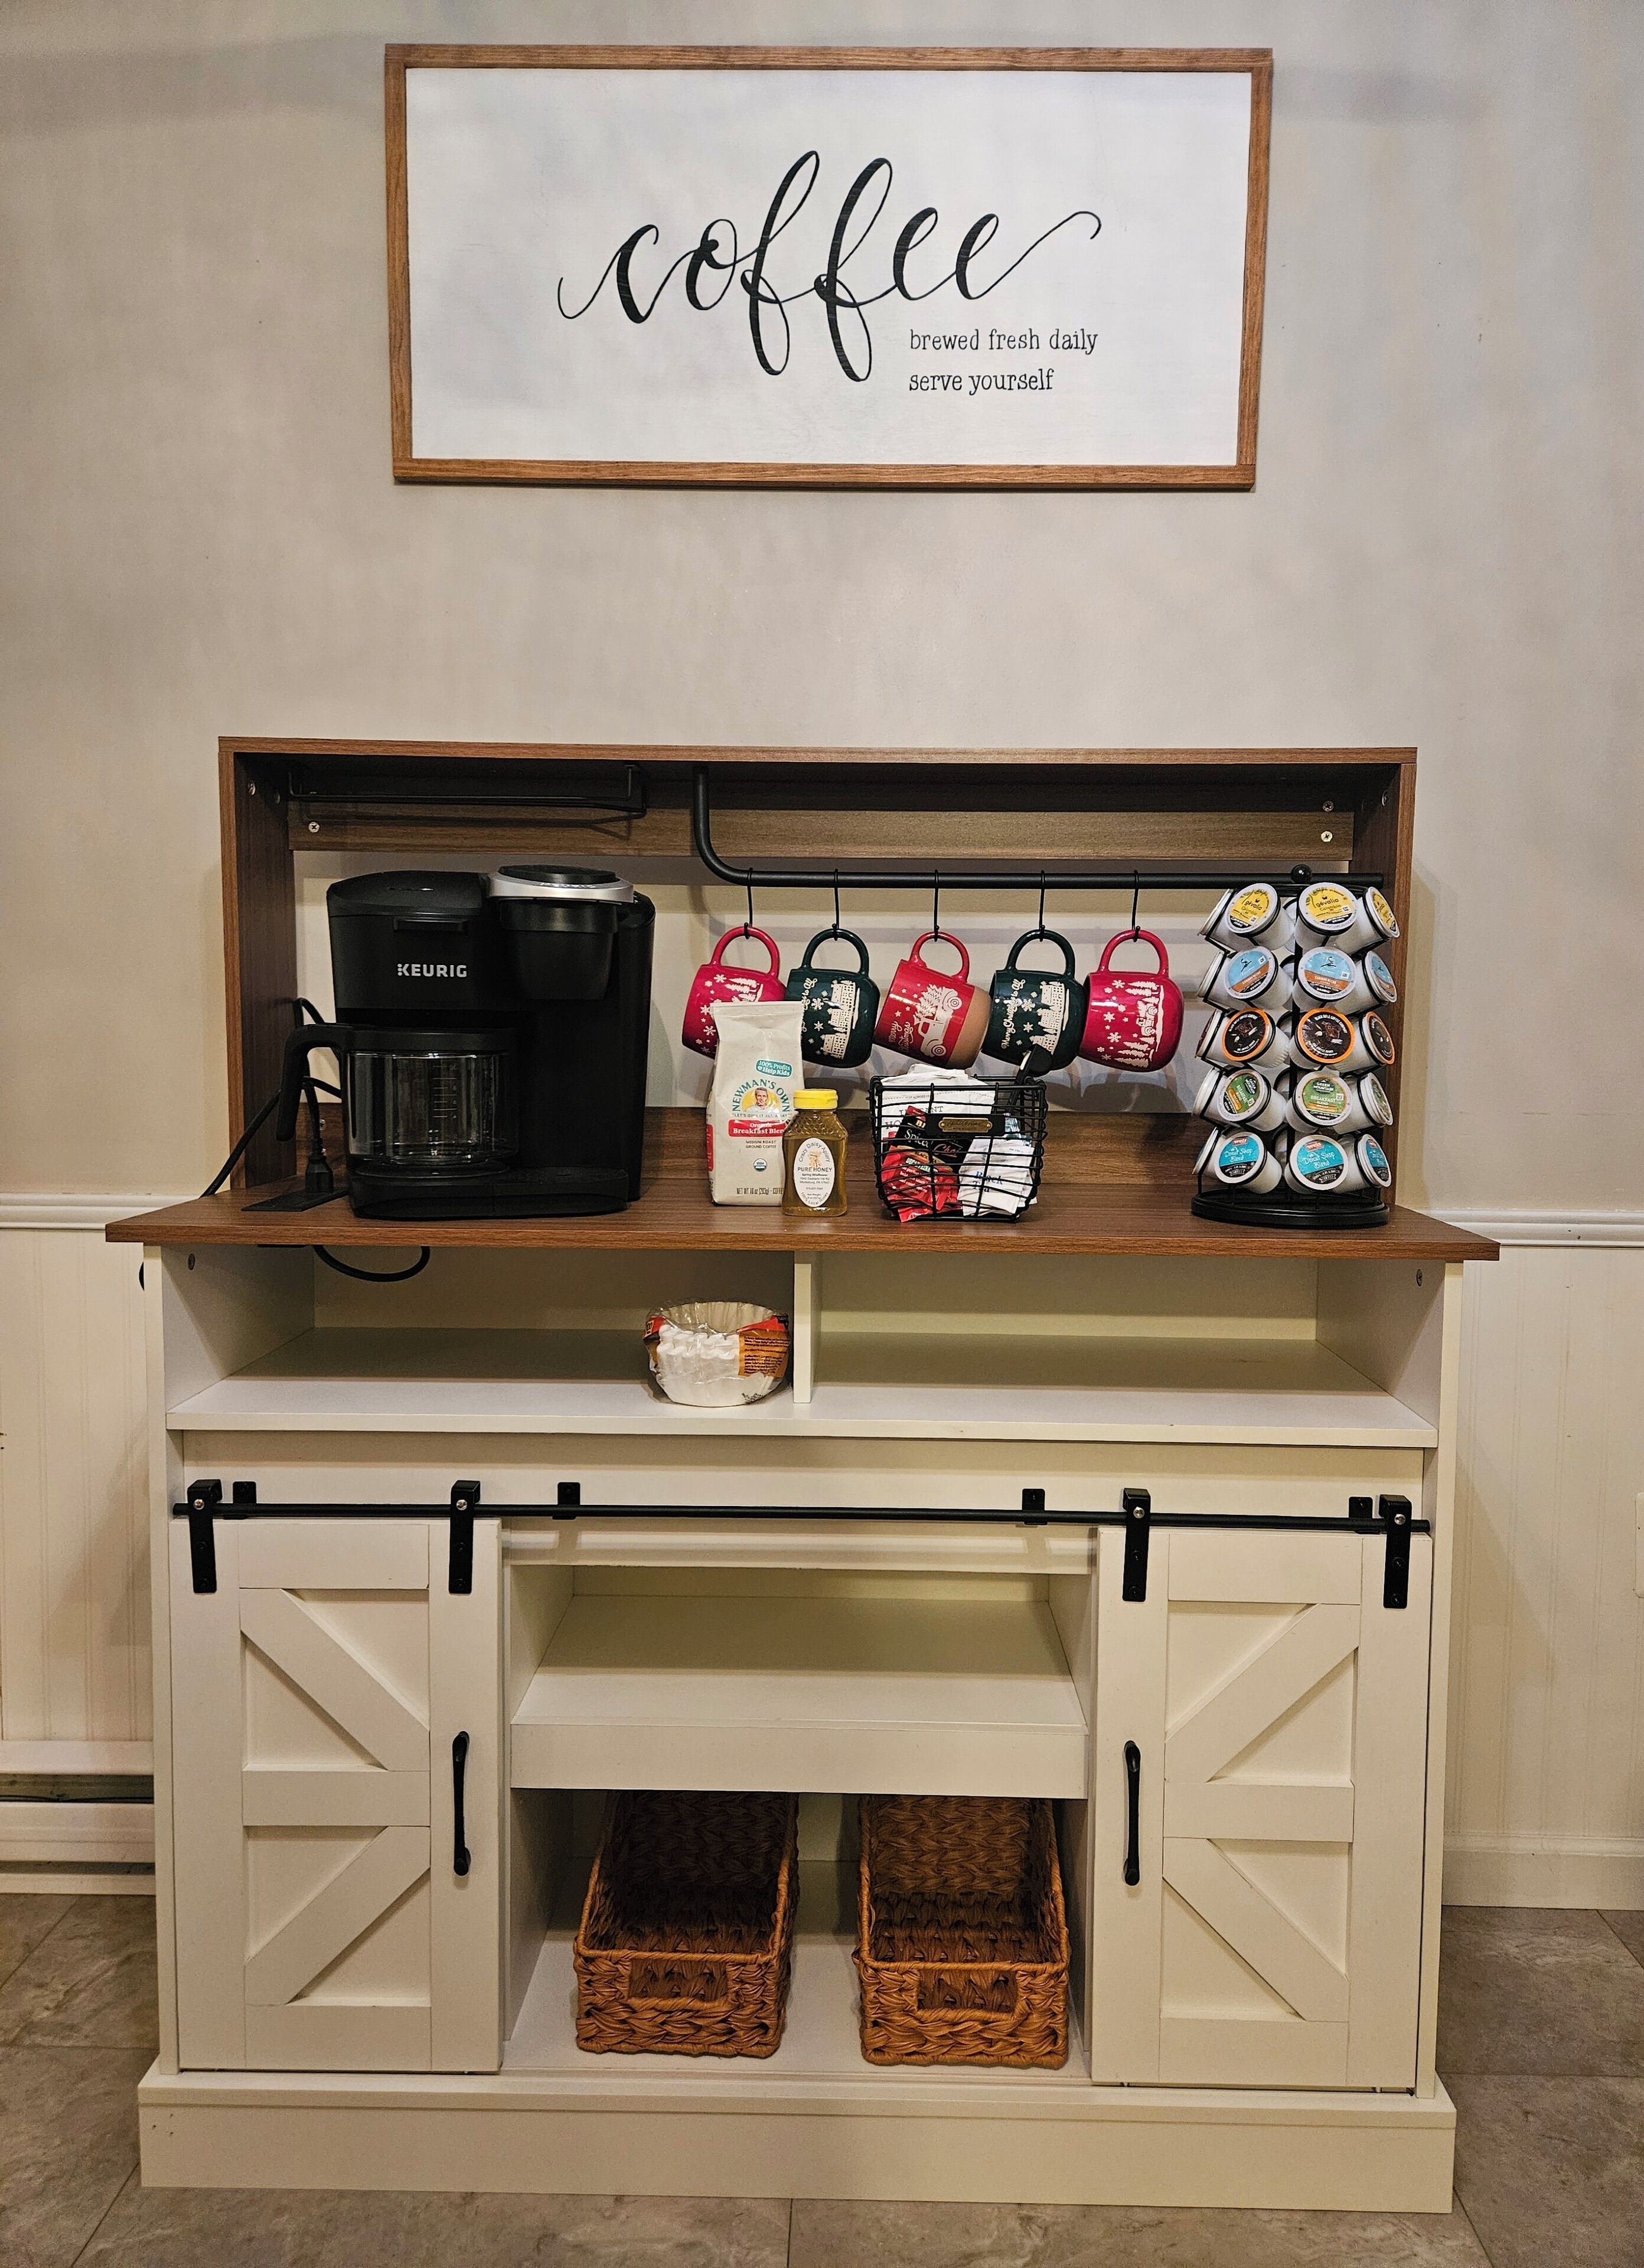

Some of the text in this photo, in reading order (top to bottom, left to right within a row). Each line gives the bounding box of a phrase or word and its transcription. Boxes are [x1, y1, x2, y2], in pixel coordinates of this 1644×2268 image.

[557, 151, 1102, 382] coffee
[910, 328, 1098, 355] brewed fresh daily
[909, 368, 1054, 396] serve yourself
[397, 964, 467, 977] KEURIG
[888, 1021, 902, 1043] Merry
[1001, 1028, 1016, 1049] Merry
[762, 1066, 777, 1075] Help
[732, 1079, 790, 1112] NEWMAN'S OWN
[798, 1149, 808, 1162] Crazy
[821, 1147, 830, 1162] Apiary
[1239, 1148, 1252, 1156] Shop
[1320, 1149, 1335, 1159] Shop
[976, 1171, 1003, 1185] Back
[973, 1180, 990, 1192] Ta
